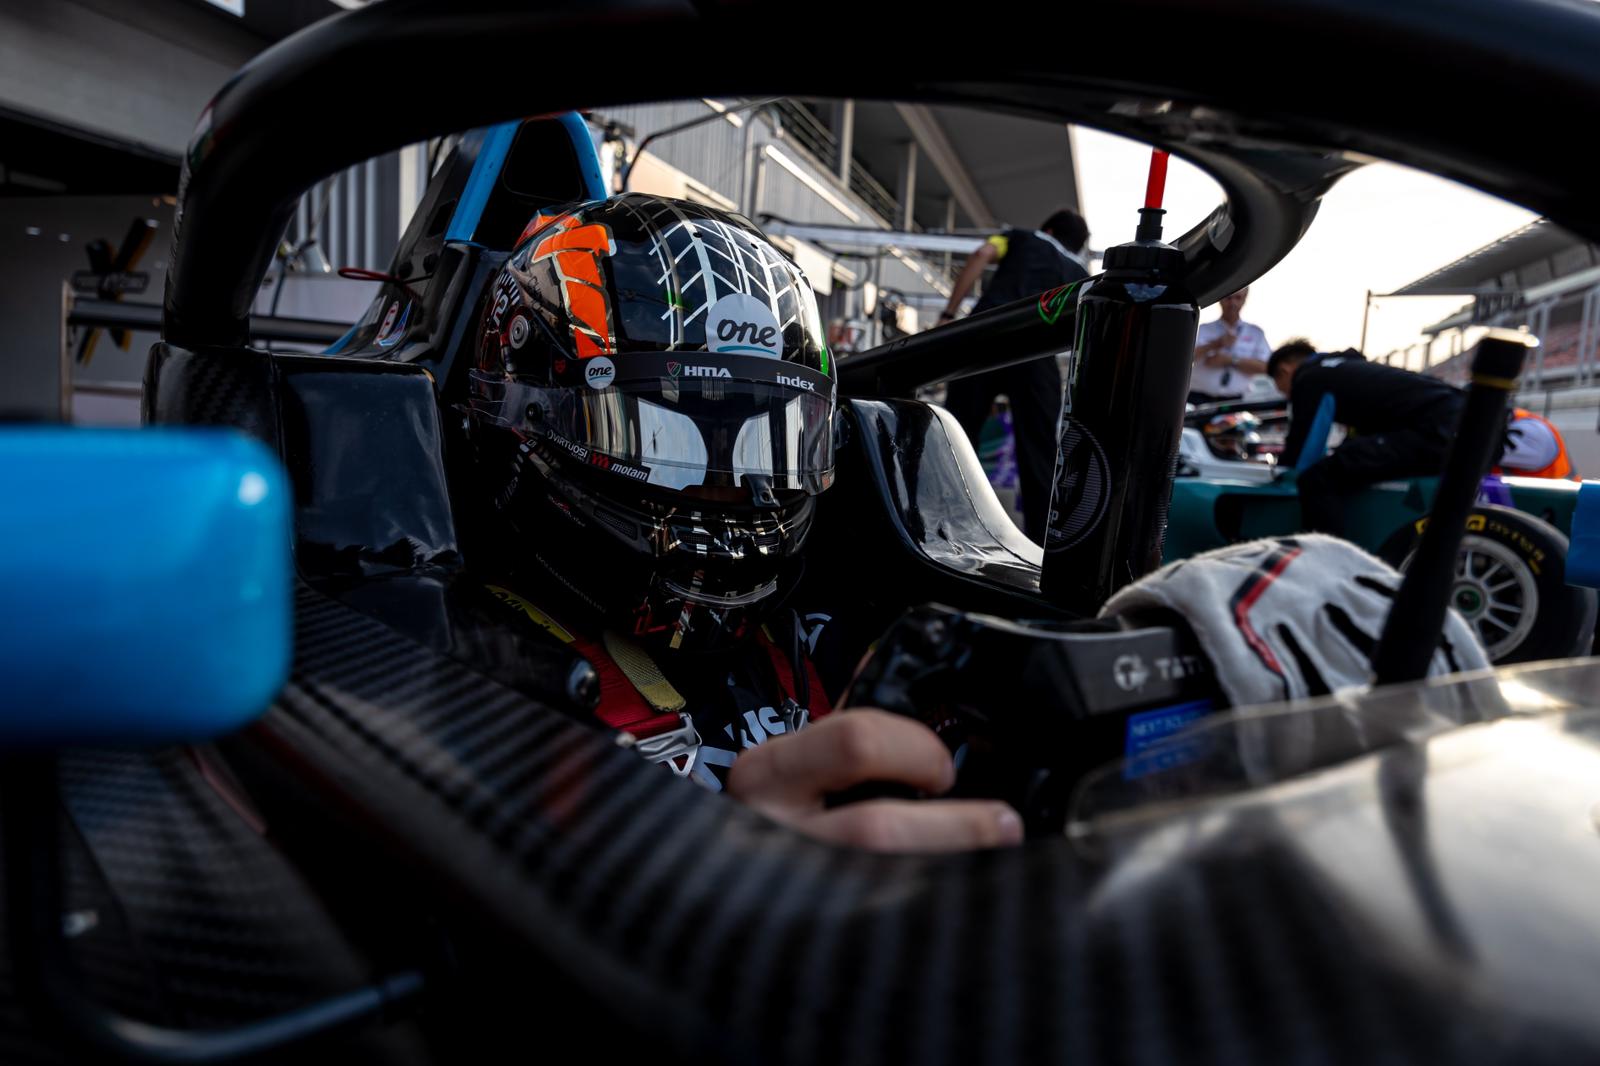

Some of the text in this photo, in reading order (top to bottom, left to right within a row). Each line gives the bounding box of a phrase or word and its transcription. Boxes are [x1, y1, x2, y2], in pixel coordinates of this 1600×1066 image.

[717, 319, 776, 348] one
[588, 364, 612, 377] one
[553, 433, 588, 458] VIRTUOSI
[611, 463, 648, 481] motam
[1154, 656, 1203, 680] TAT
